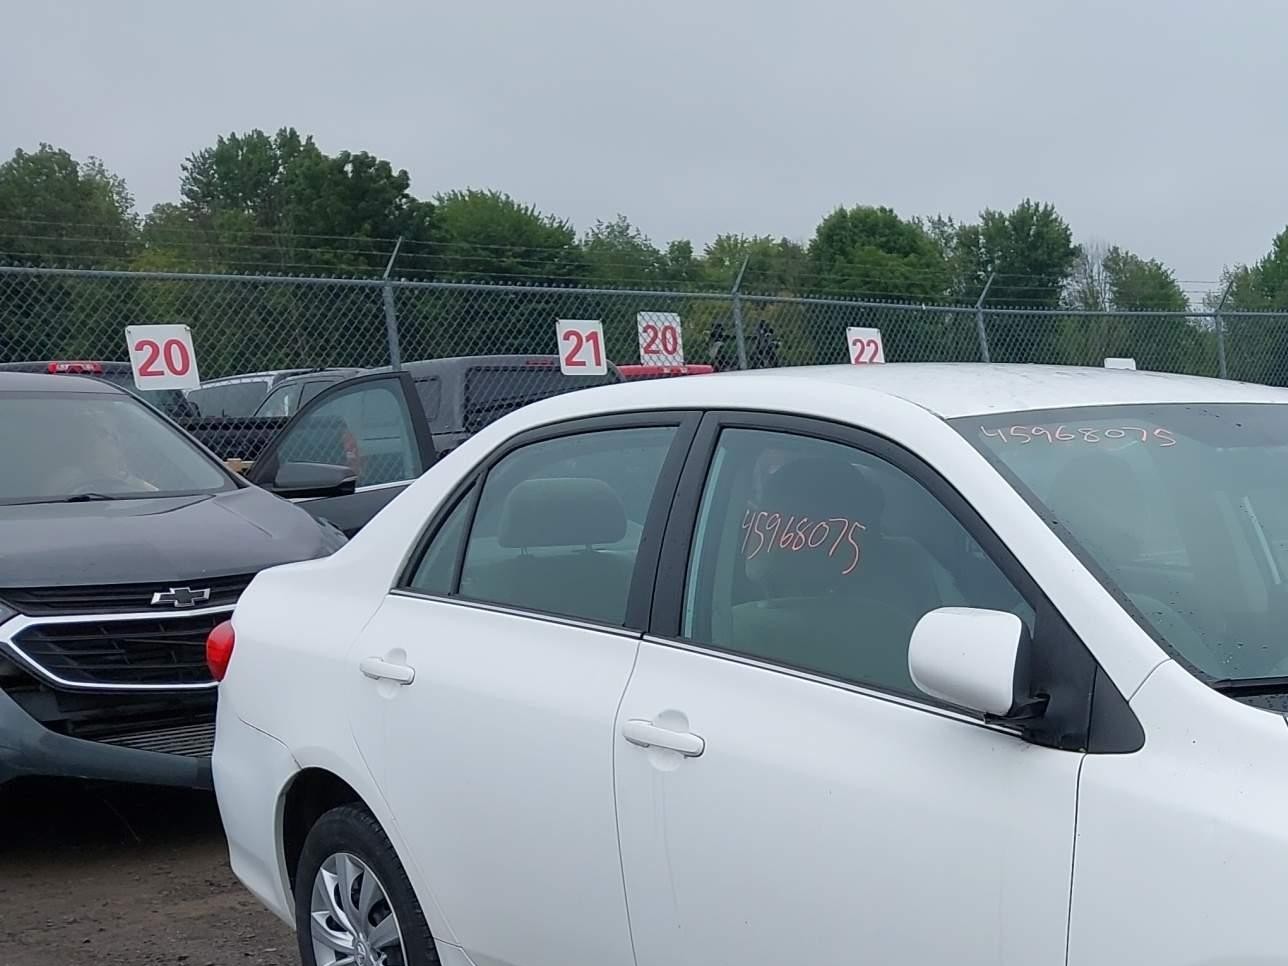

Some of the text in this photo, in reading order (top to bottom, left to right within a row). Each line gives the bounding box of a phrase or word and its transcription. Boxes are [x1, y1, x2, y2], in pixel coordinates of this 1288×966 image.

[562, 329, 602, 367] 21
[641, 324, 678, 355] 20
[852, 338, 880, 364] 22
[134, 338, 190, 376] 20
[980, 425, 1176, 447] 45968075
[741, 509, 866, 575] 45968075
